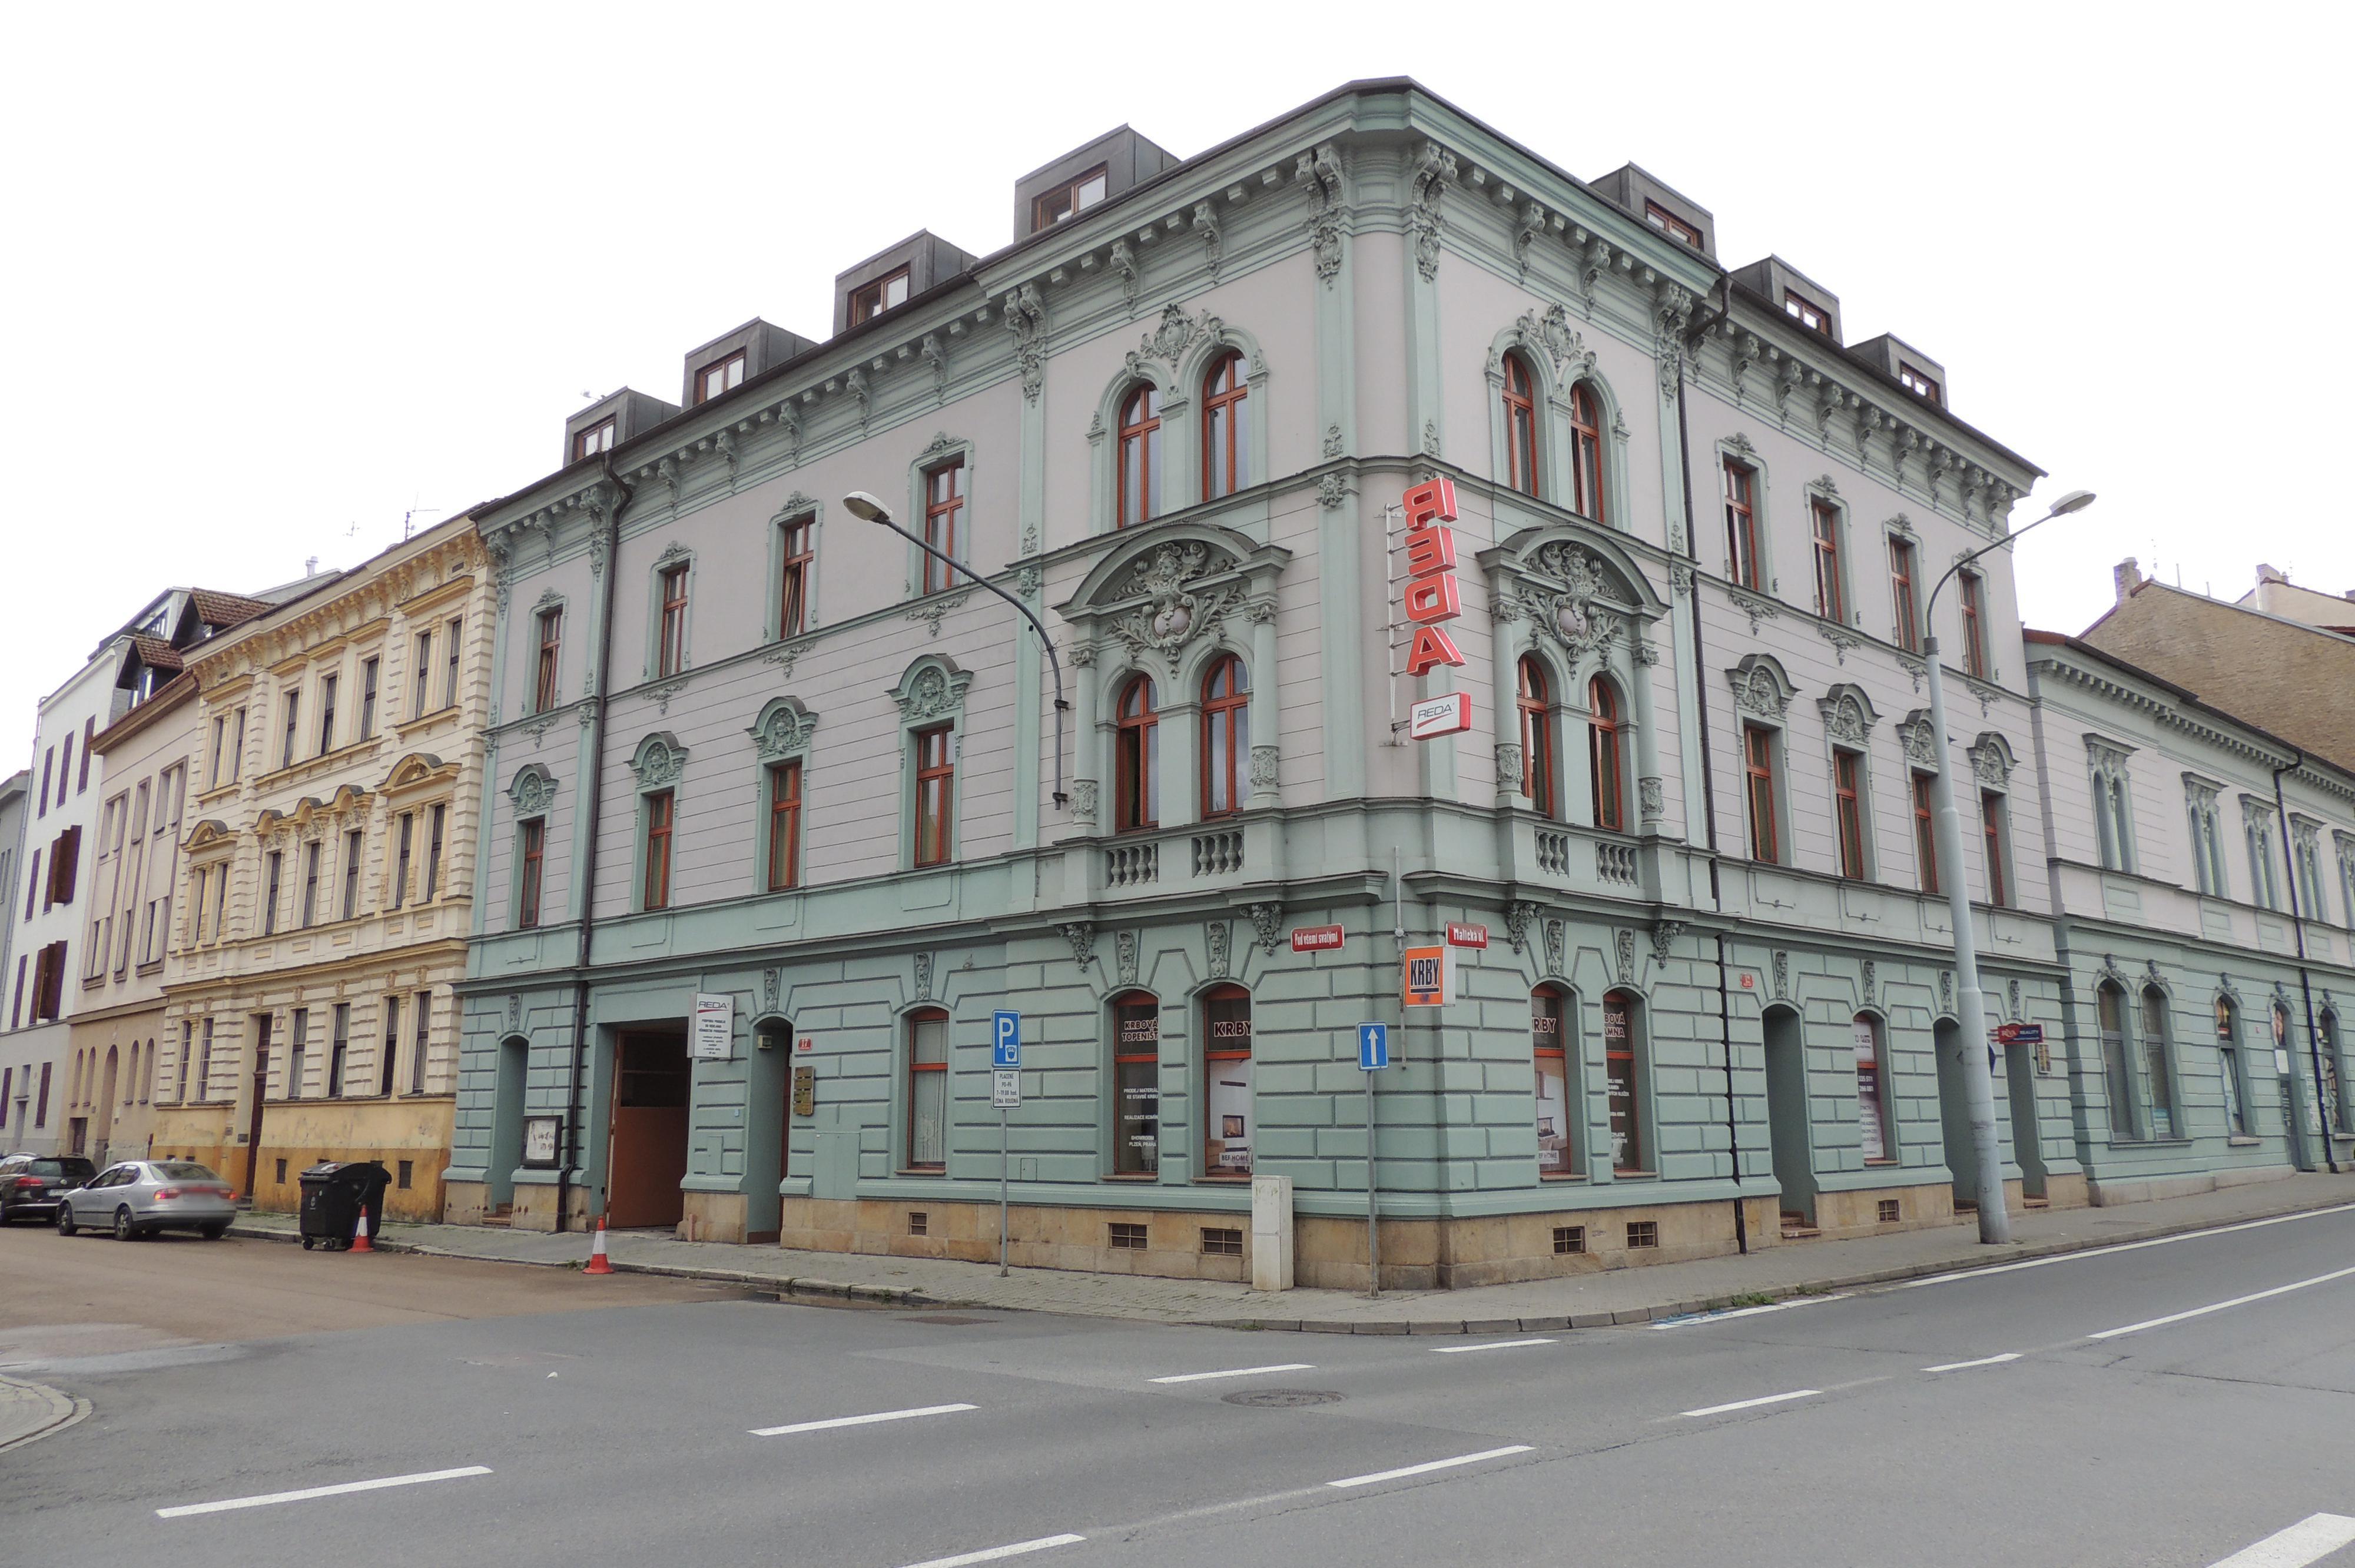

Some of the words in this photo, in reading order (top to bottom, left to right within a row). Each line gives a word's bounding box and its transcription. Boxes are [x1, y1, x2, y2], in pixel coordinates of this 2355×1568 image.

[1418, 704, 1452, 719] REDA
[1295, 932, 1303, 946] Pod
[1303, 933, 1318, 945] všemi
[1318, 931, 1338, 945] svatými
[1410, 958, 1439, 987] KRBY
[1125, 1017, 1158, 1030] KRBOVÁ
[1214, 1021, 1252, 1037] KRBY
[1532, 1017, 1556, 1033] RBY
[999, 1018, 1014, 1048] P
[802, 1039, 808, 1047] 17
